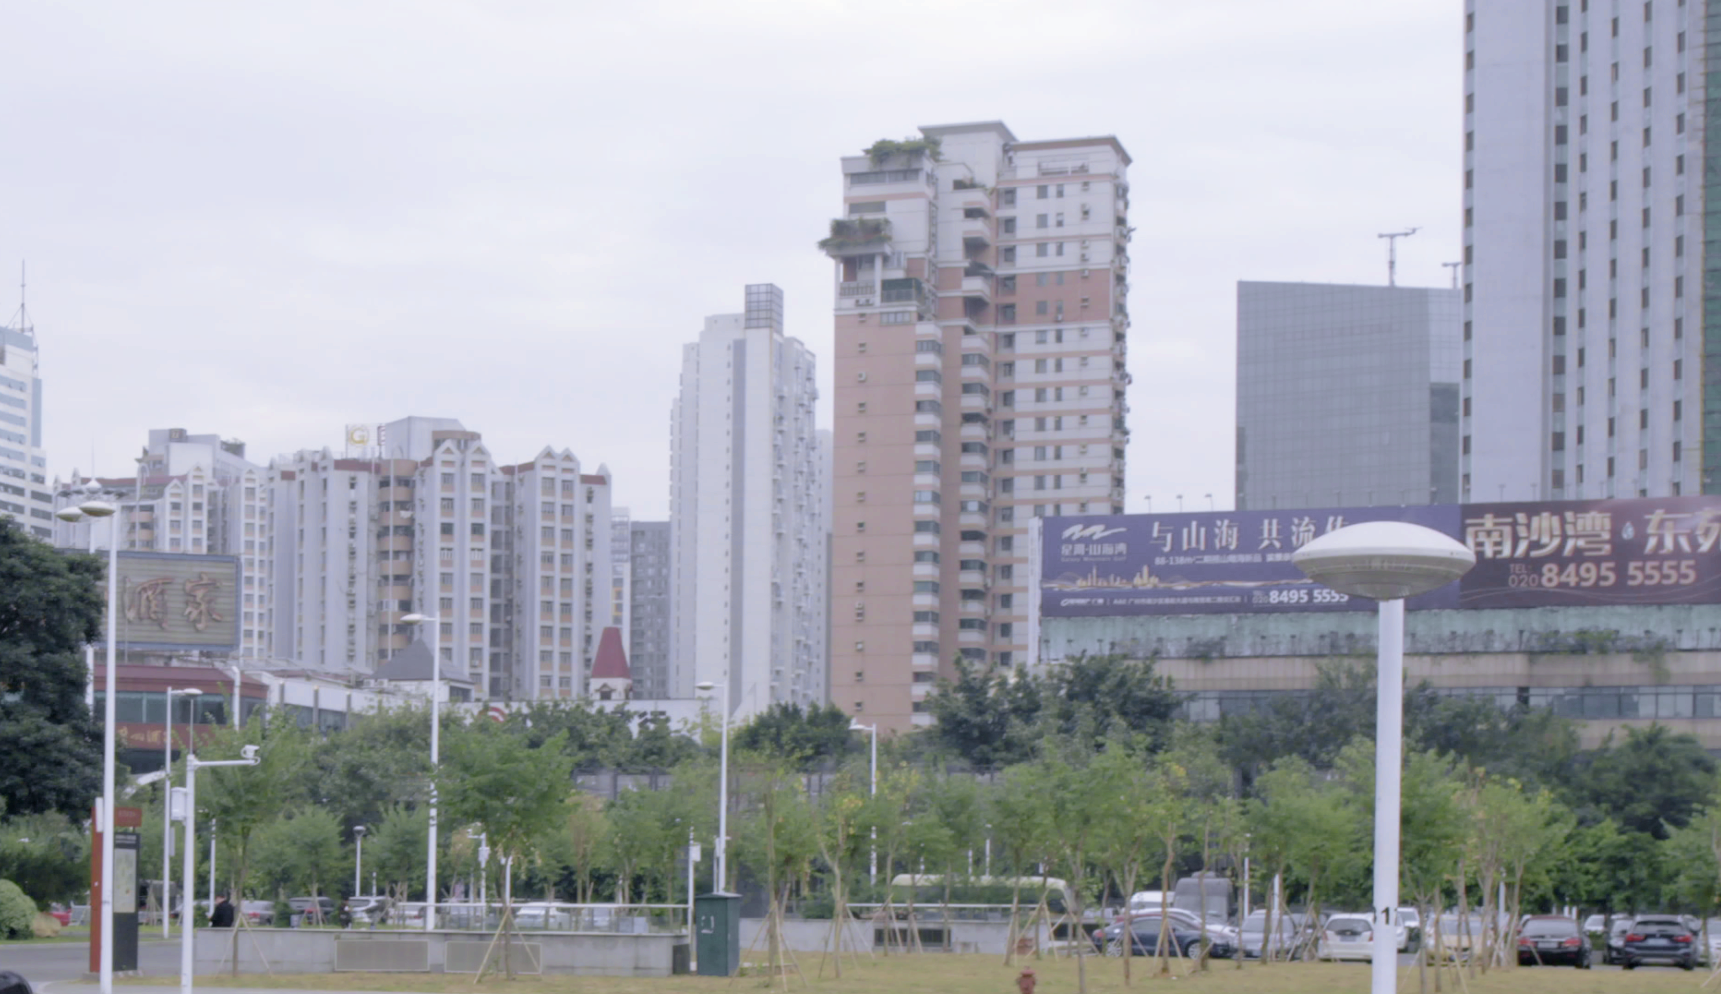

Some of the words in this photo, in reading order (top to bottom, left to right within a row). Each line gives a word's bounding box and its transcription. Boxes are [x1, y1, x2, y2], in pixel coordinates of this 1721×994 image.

[1149, 518, 1240, 552] 与山海
[1465, 511, 1612, 559] 南沙湾
[1508, 573, 1538, 588] 020
[1541, 562, 1616, 587] 8495
[1626, 560, 1697, 586] 5555
[1269, 589, 1309, 604] 8495
